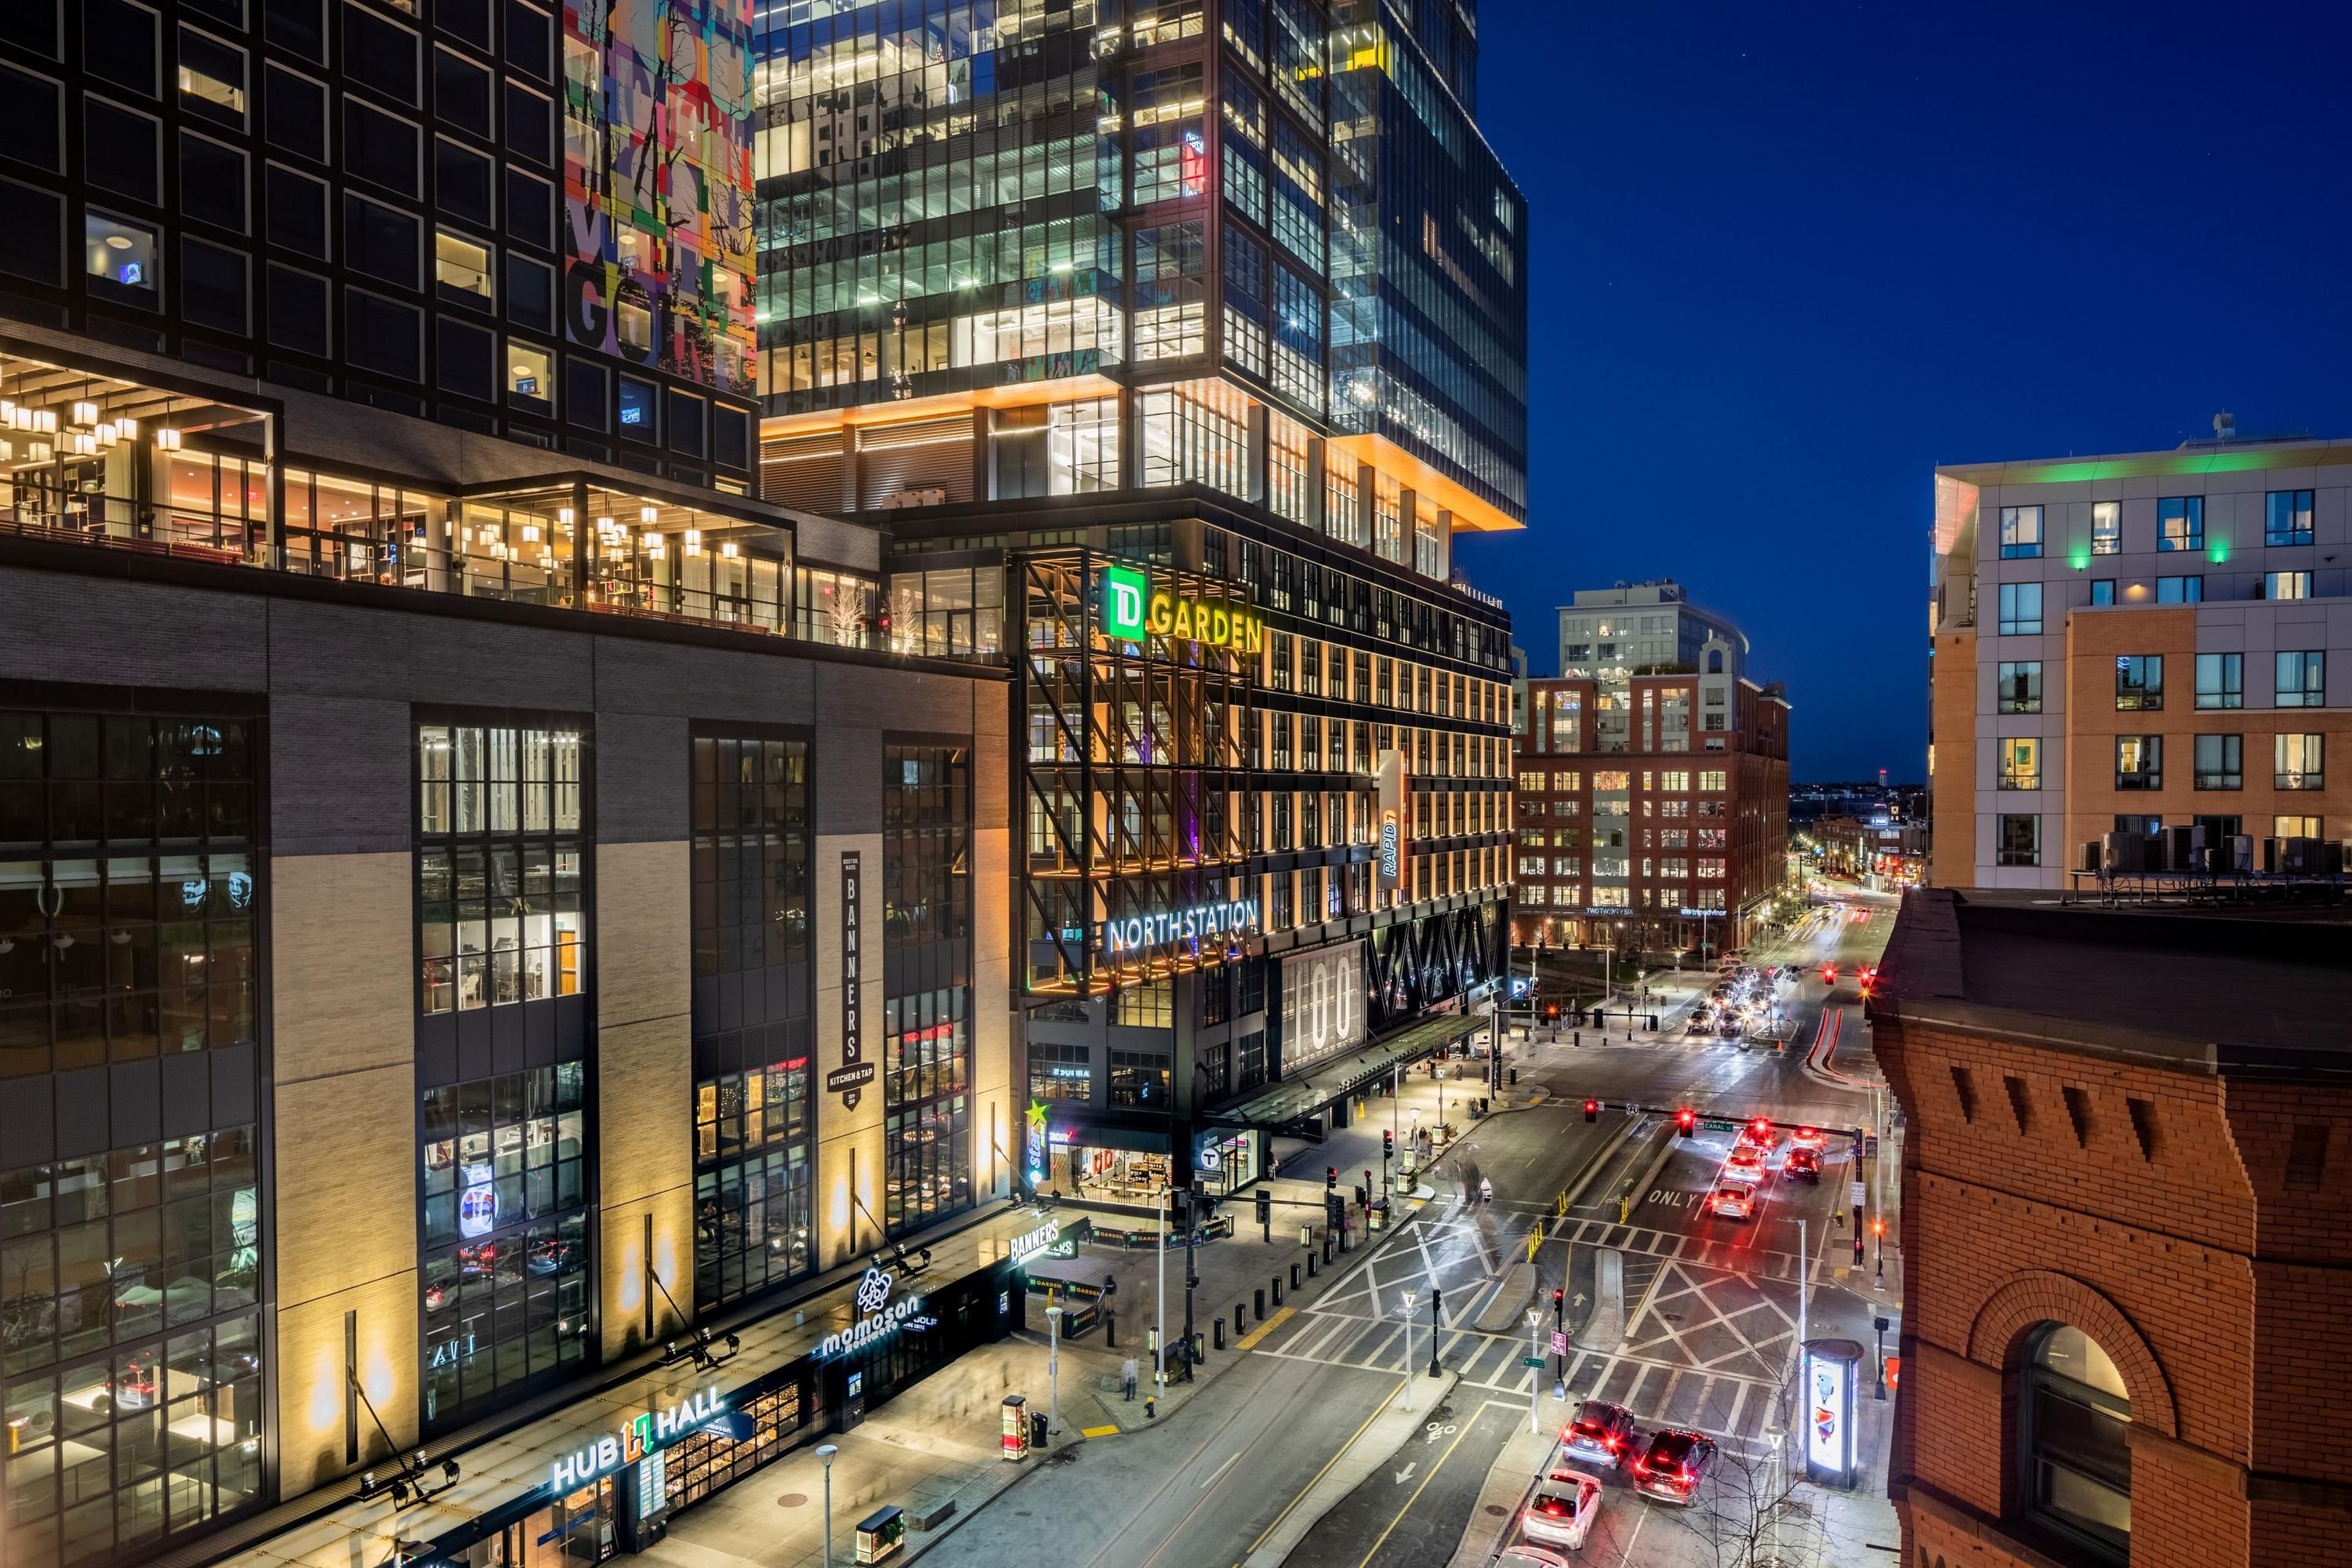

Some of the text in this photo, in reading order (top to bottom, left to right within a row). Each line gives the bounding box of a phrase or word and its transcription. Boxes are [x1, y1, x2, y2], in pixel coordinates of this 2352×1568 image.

[1111, 582, 1262, 653] TD GARDEN
[1383, 811, 1396, 877] RAPID7
[1110, 900, 1258, 952] NORTH STATION
[1513, 981, 1526, 997] P
[1295, 956, 1350, 1058] 100
[829, 1072, 855, 1086] KITCHEN
[861, 1068, 873, 1077] TAP
[1029, 1127, 1040, 1168] star
[1203, 1153, 1215, 1165] T
[1648, 1190, 1698, 1208] ONLY
[1010, 1218, 1058, 1264] BANNERS
[1036, 1280, 1062, 1289] GARDEN
[1076, 1287, 1101, 1296] GARDEN
[823, 1297, 917, 1356] momosan
[1078, 1311, 1096, 1323] GARDEN
[554, 1437, 618, 1492] HUB
[657, 1386, 724, 1439] HALL
[704, 1424, 731, 1434] omosan
